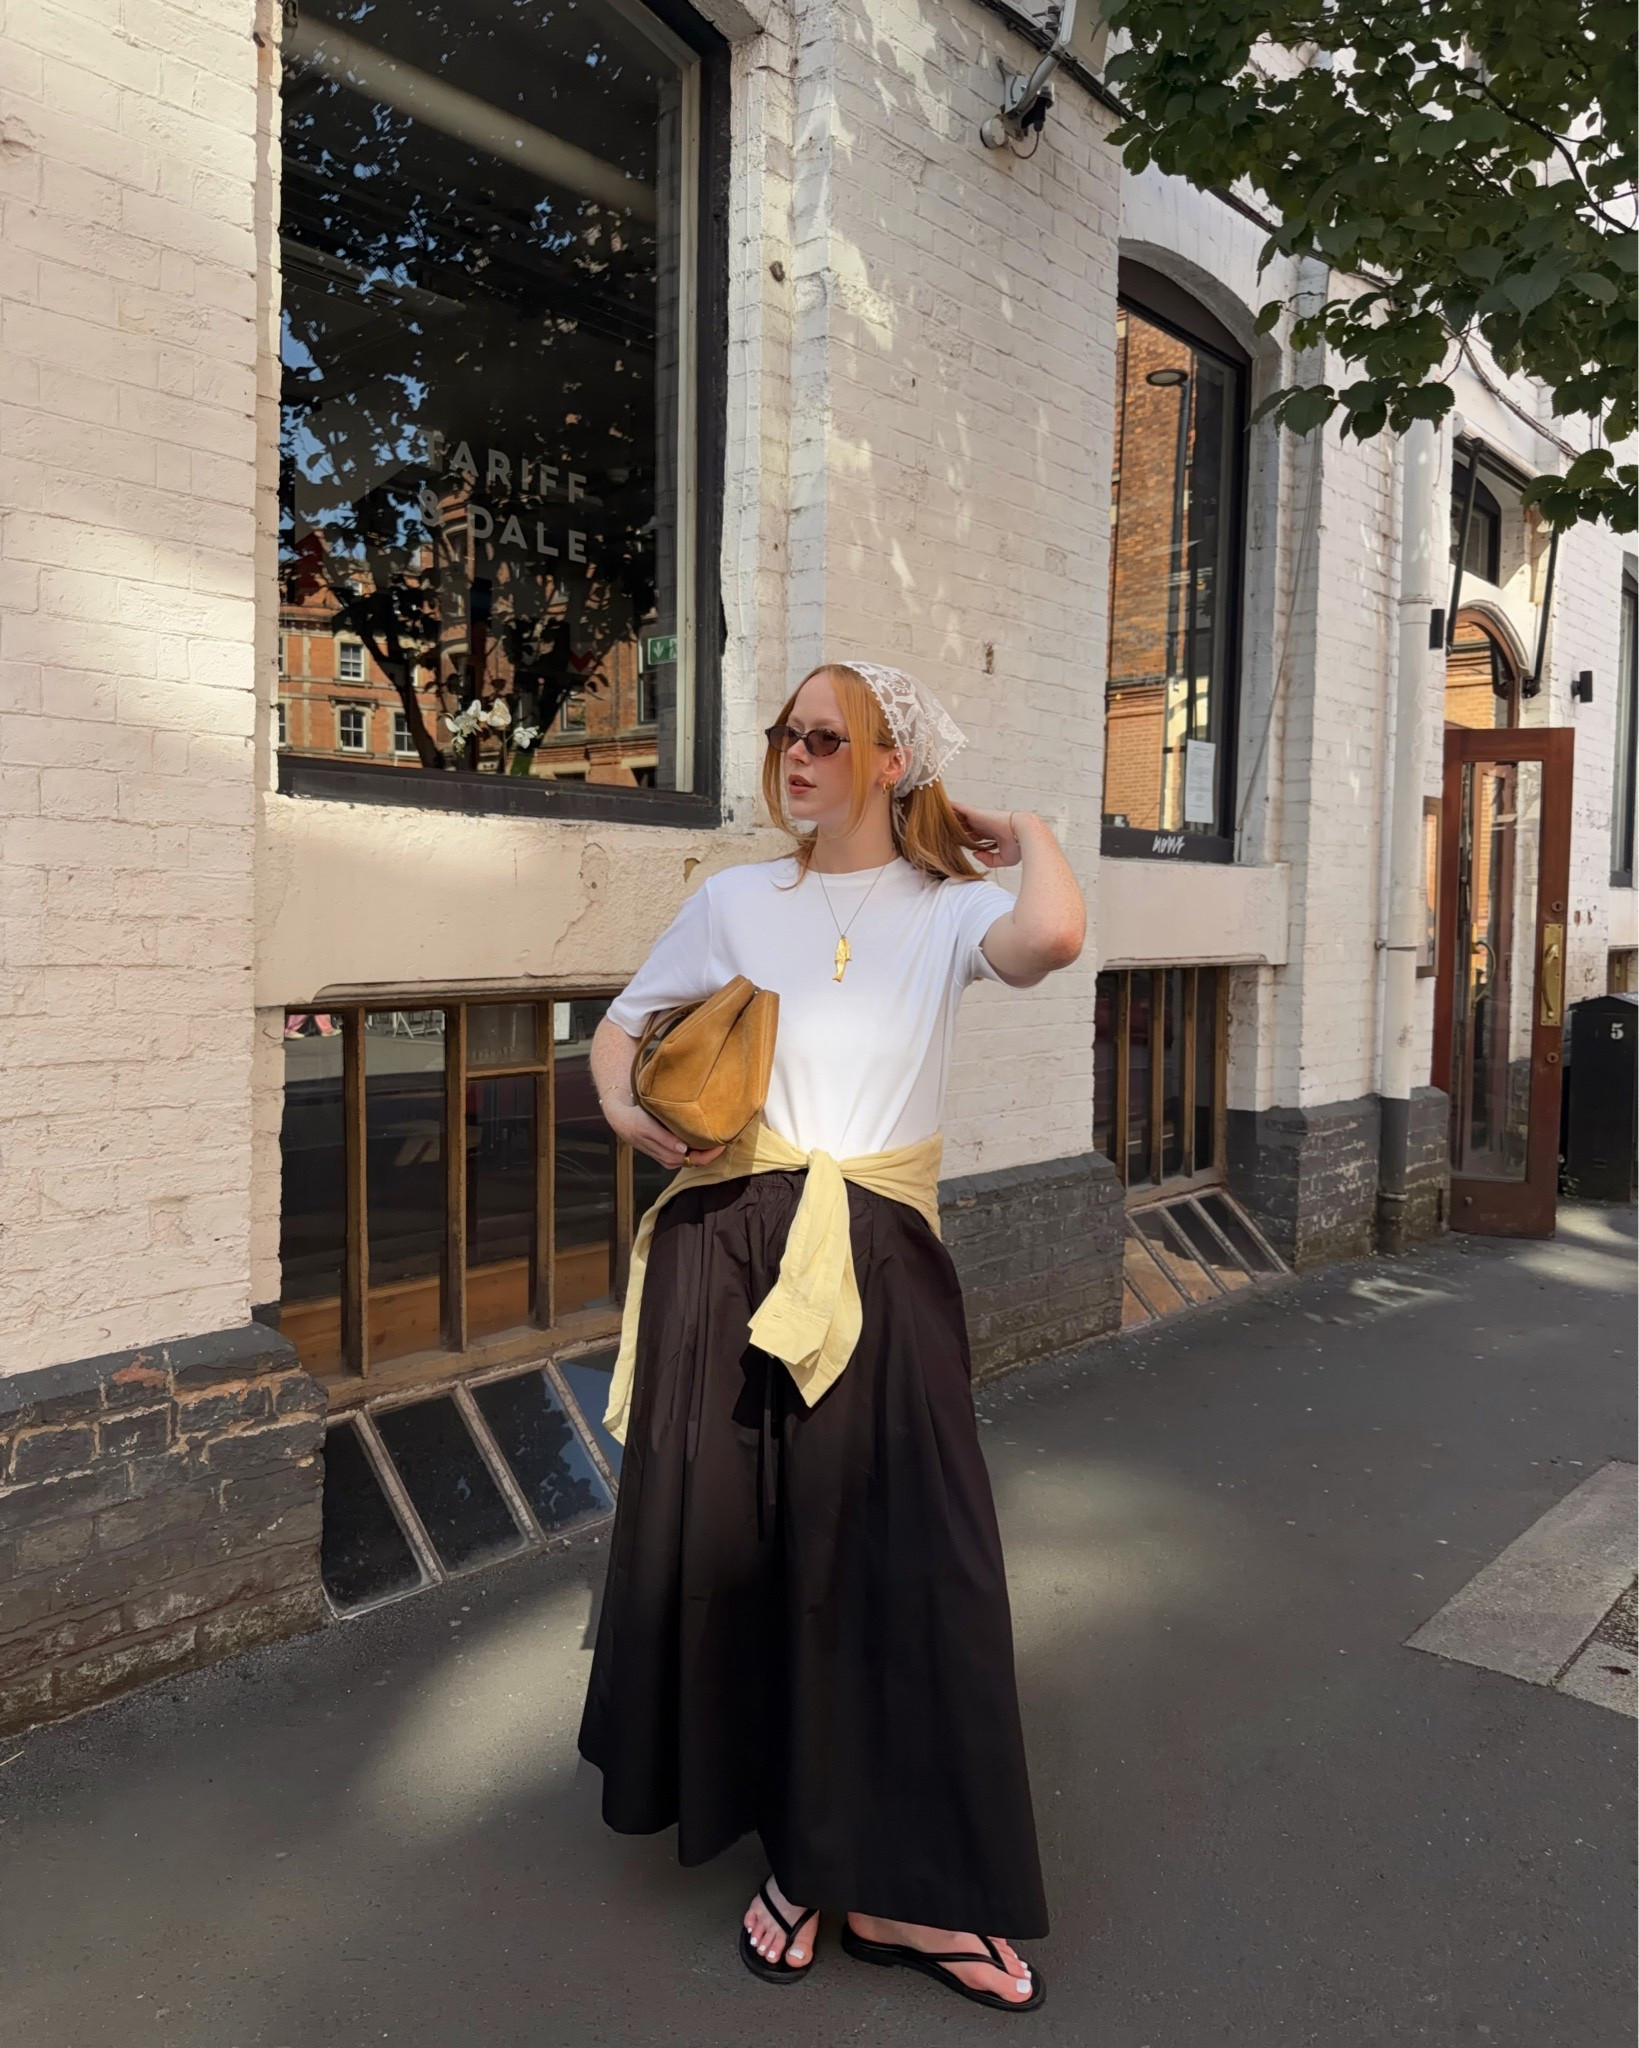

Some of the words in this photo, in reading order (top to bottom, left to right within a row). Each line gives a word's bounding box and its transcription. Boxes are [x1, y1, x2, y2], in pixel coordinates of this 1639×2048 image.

[418, 429, 587, 503] TARIFF
[418, 489, 446, 527] &
[467, 504, 587, 564] DALE
[1610, 1022, 1624, 1040] 5
